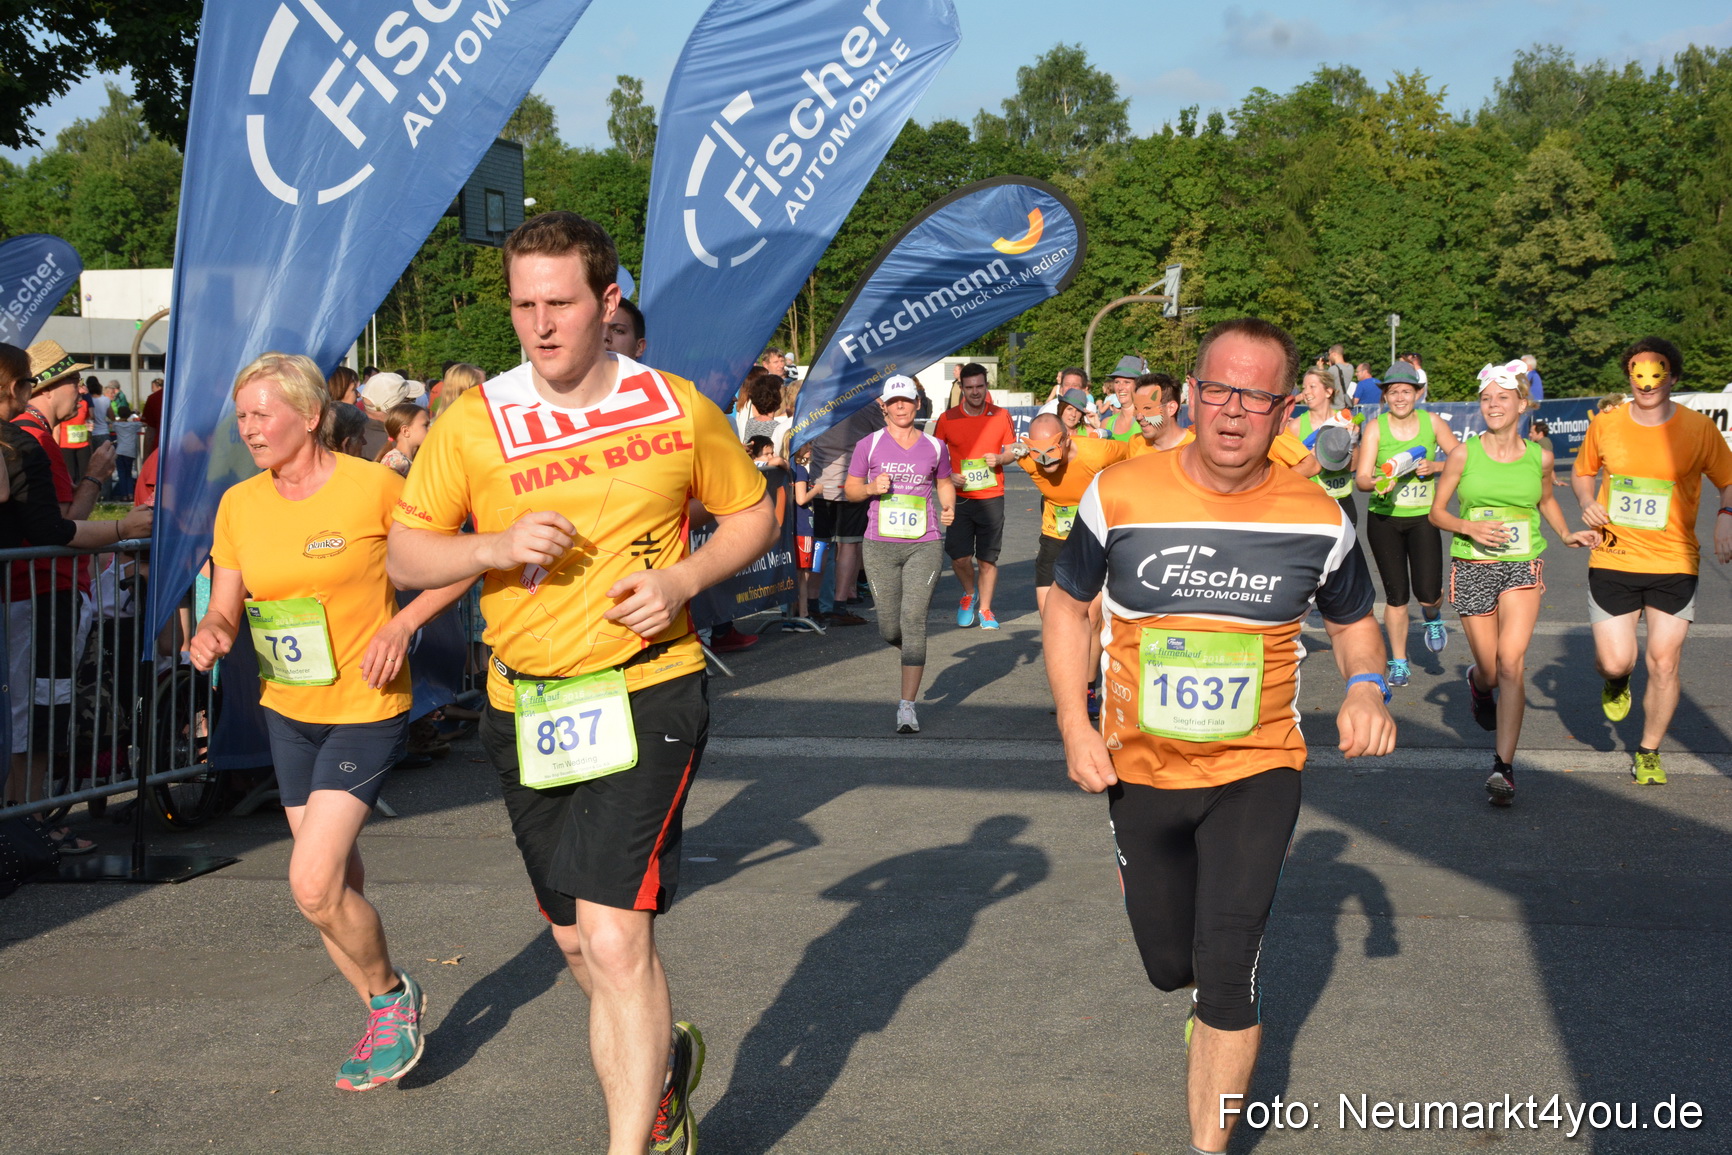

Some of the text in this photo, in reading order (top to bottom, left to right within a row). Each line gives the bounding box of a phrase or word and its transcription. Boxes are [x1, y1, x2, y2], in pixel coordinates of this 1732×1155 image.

[403, 0, 515, 149] AUTOM
[724, 0, 890, 228] Fischer
[785, 37, 911, 225] AUTOMOBILE
[950, 247, 1070, 320] Druck und Medien
[16, 268, 65, 332] AUTOMOBILE
[838, 258, 1010, 364] Frischmann
[787, 361, 898, 439] www.frischmann-net.de
[509, 430, 693, 496] MAX BÖGL
[881, 462, 916, 473] HECK
[967, 469, 990, 482] 984
[1325, 478, 1346, 491] 309
[1400, 485, 1428, 499] 312
[889, 511, 918, 527] 516
[1619, 495, 1657, 516] 318
[1161, 564, 1283, 591] Fischer
[1171, 588, 1273, 603] AUTOMOBILE
[264, 635, 302, 662] 73
[1158, 647, 1202, 659] firmenlauf
[1153, 673, 1250, 710] 1637
[537, 708, 602, 756] 837
